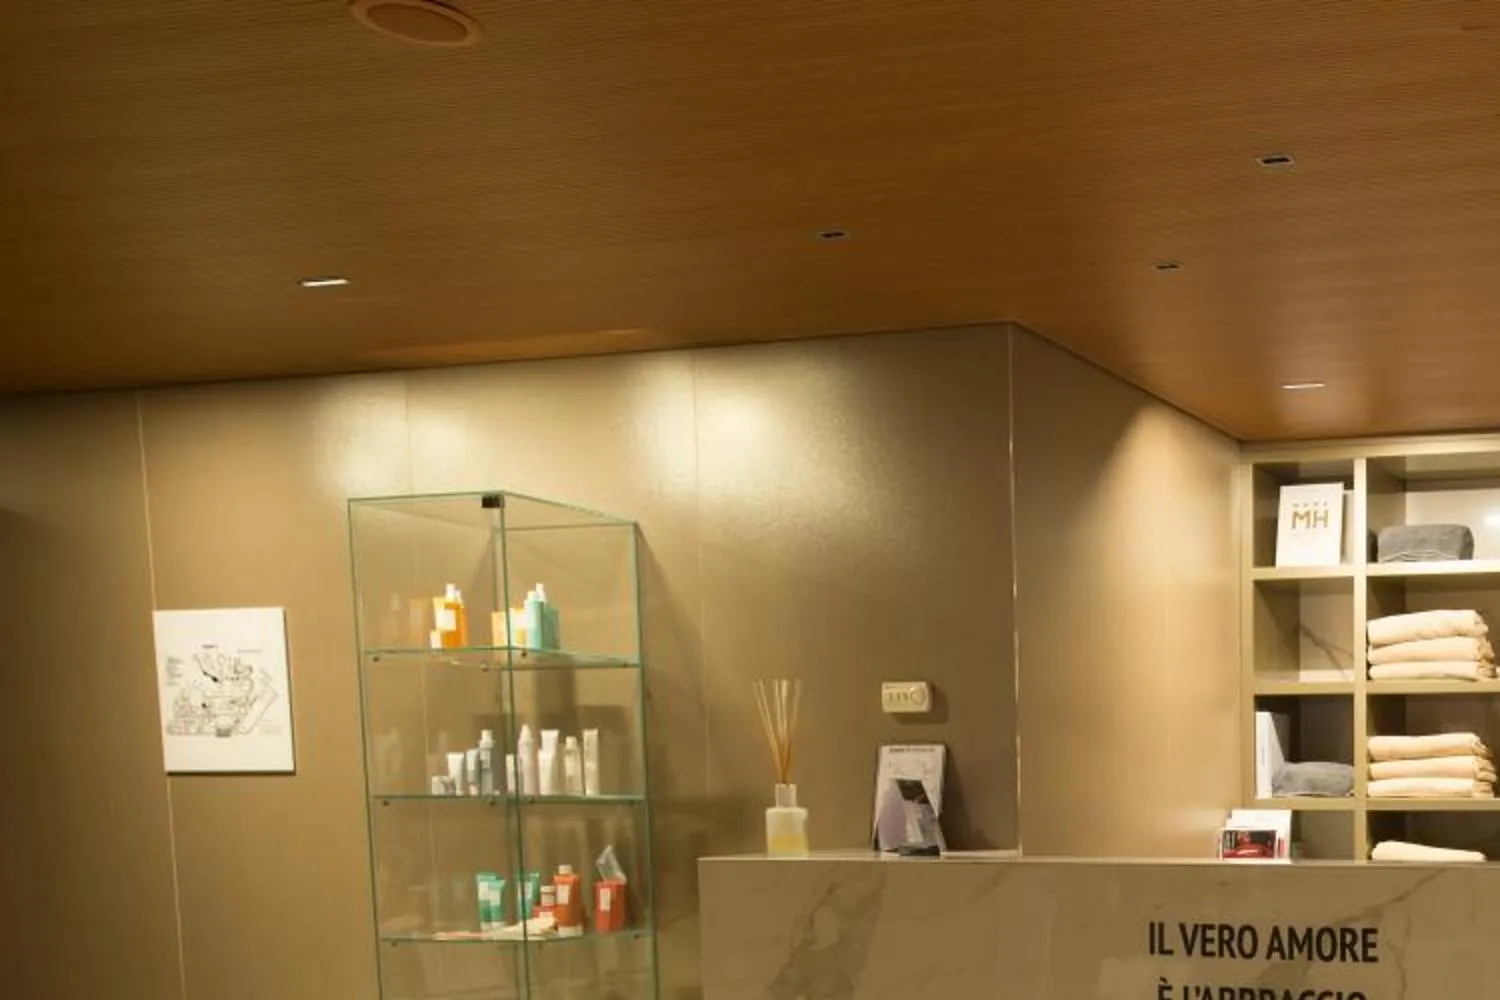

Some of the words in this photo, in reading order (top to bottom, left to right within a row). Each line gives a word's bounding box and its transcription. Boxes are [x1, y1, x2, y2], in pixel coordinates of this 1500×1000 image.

[1291, 509, 1329, 530] MH
[1149, 921, 1174, 956] IL
[1179, 922, 1259, 960] VERO
[1266, 925, 1379, 963] AMORE
